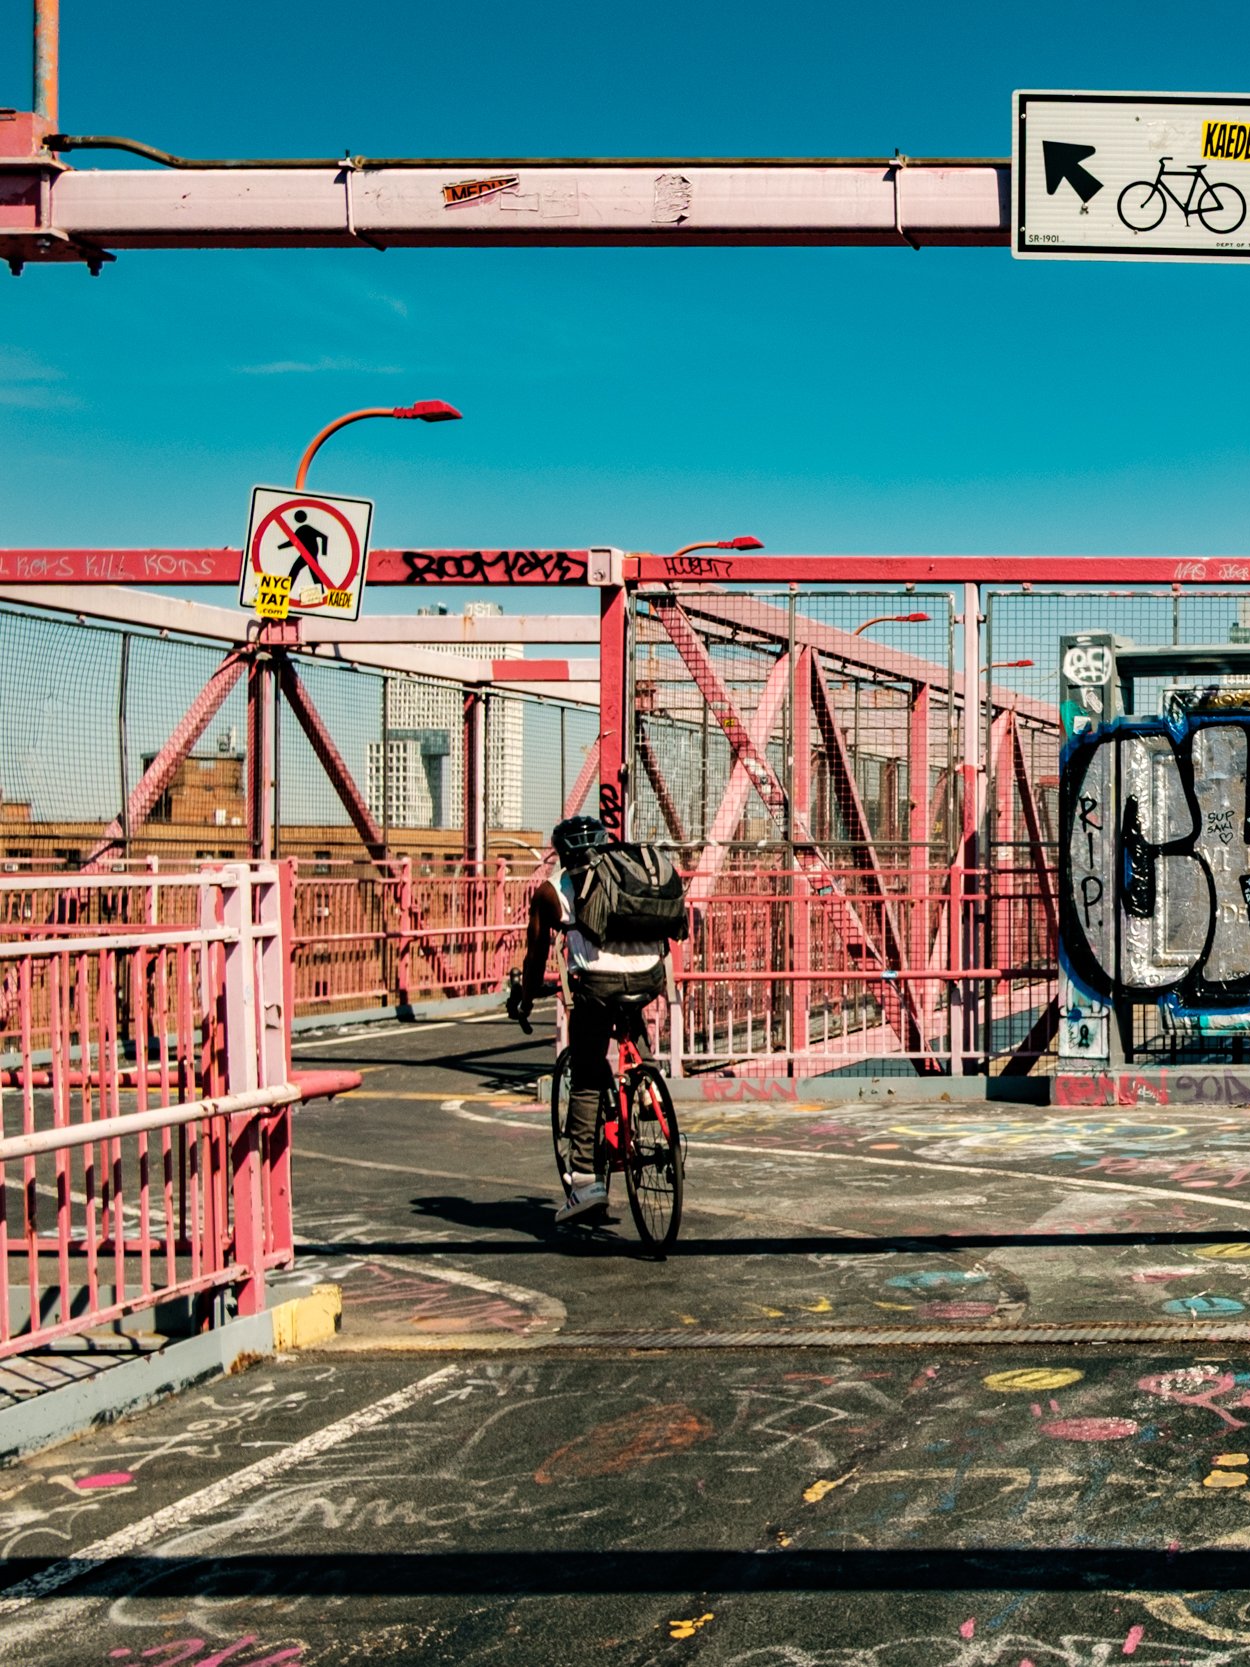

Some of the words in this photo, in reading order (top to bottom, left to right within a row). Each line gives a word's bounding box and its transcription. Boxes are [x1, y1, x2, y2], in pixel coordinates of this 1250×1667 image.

[261, 576, 290, 589] NYC
[261, 592, 287, 606] TAT
[328, 591, 353, 608] KAEDE
[1208, 810, 1235, 823] SUP
